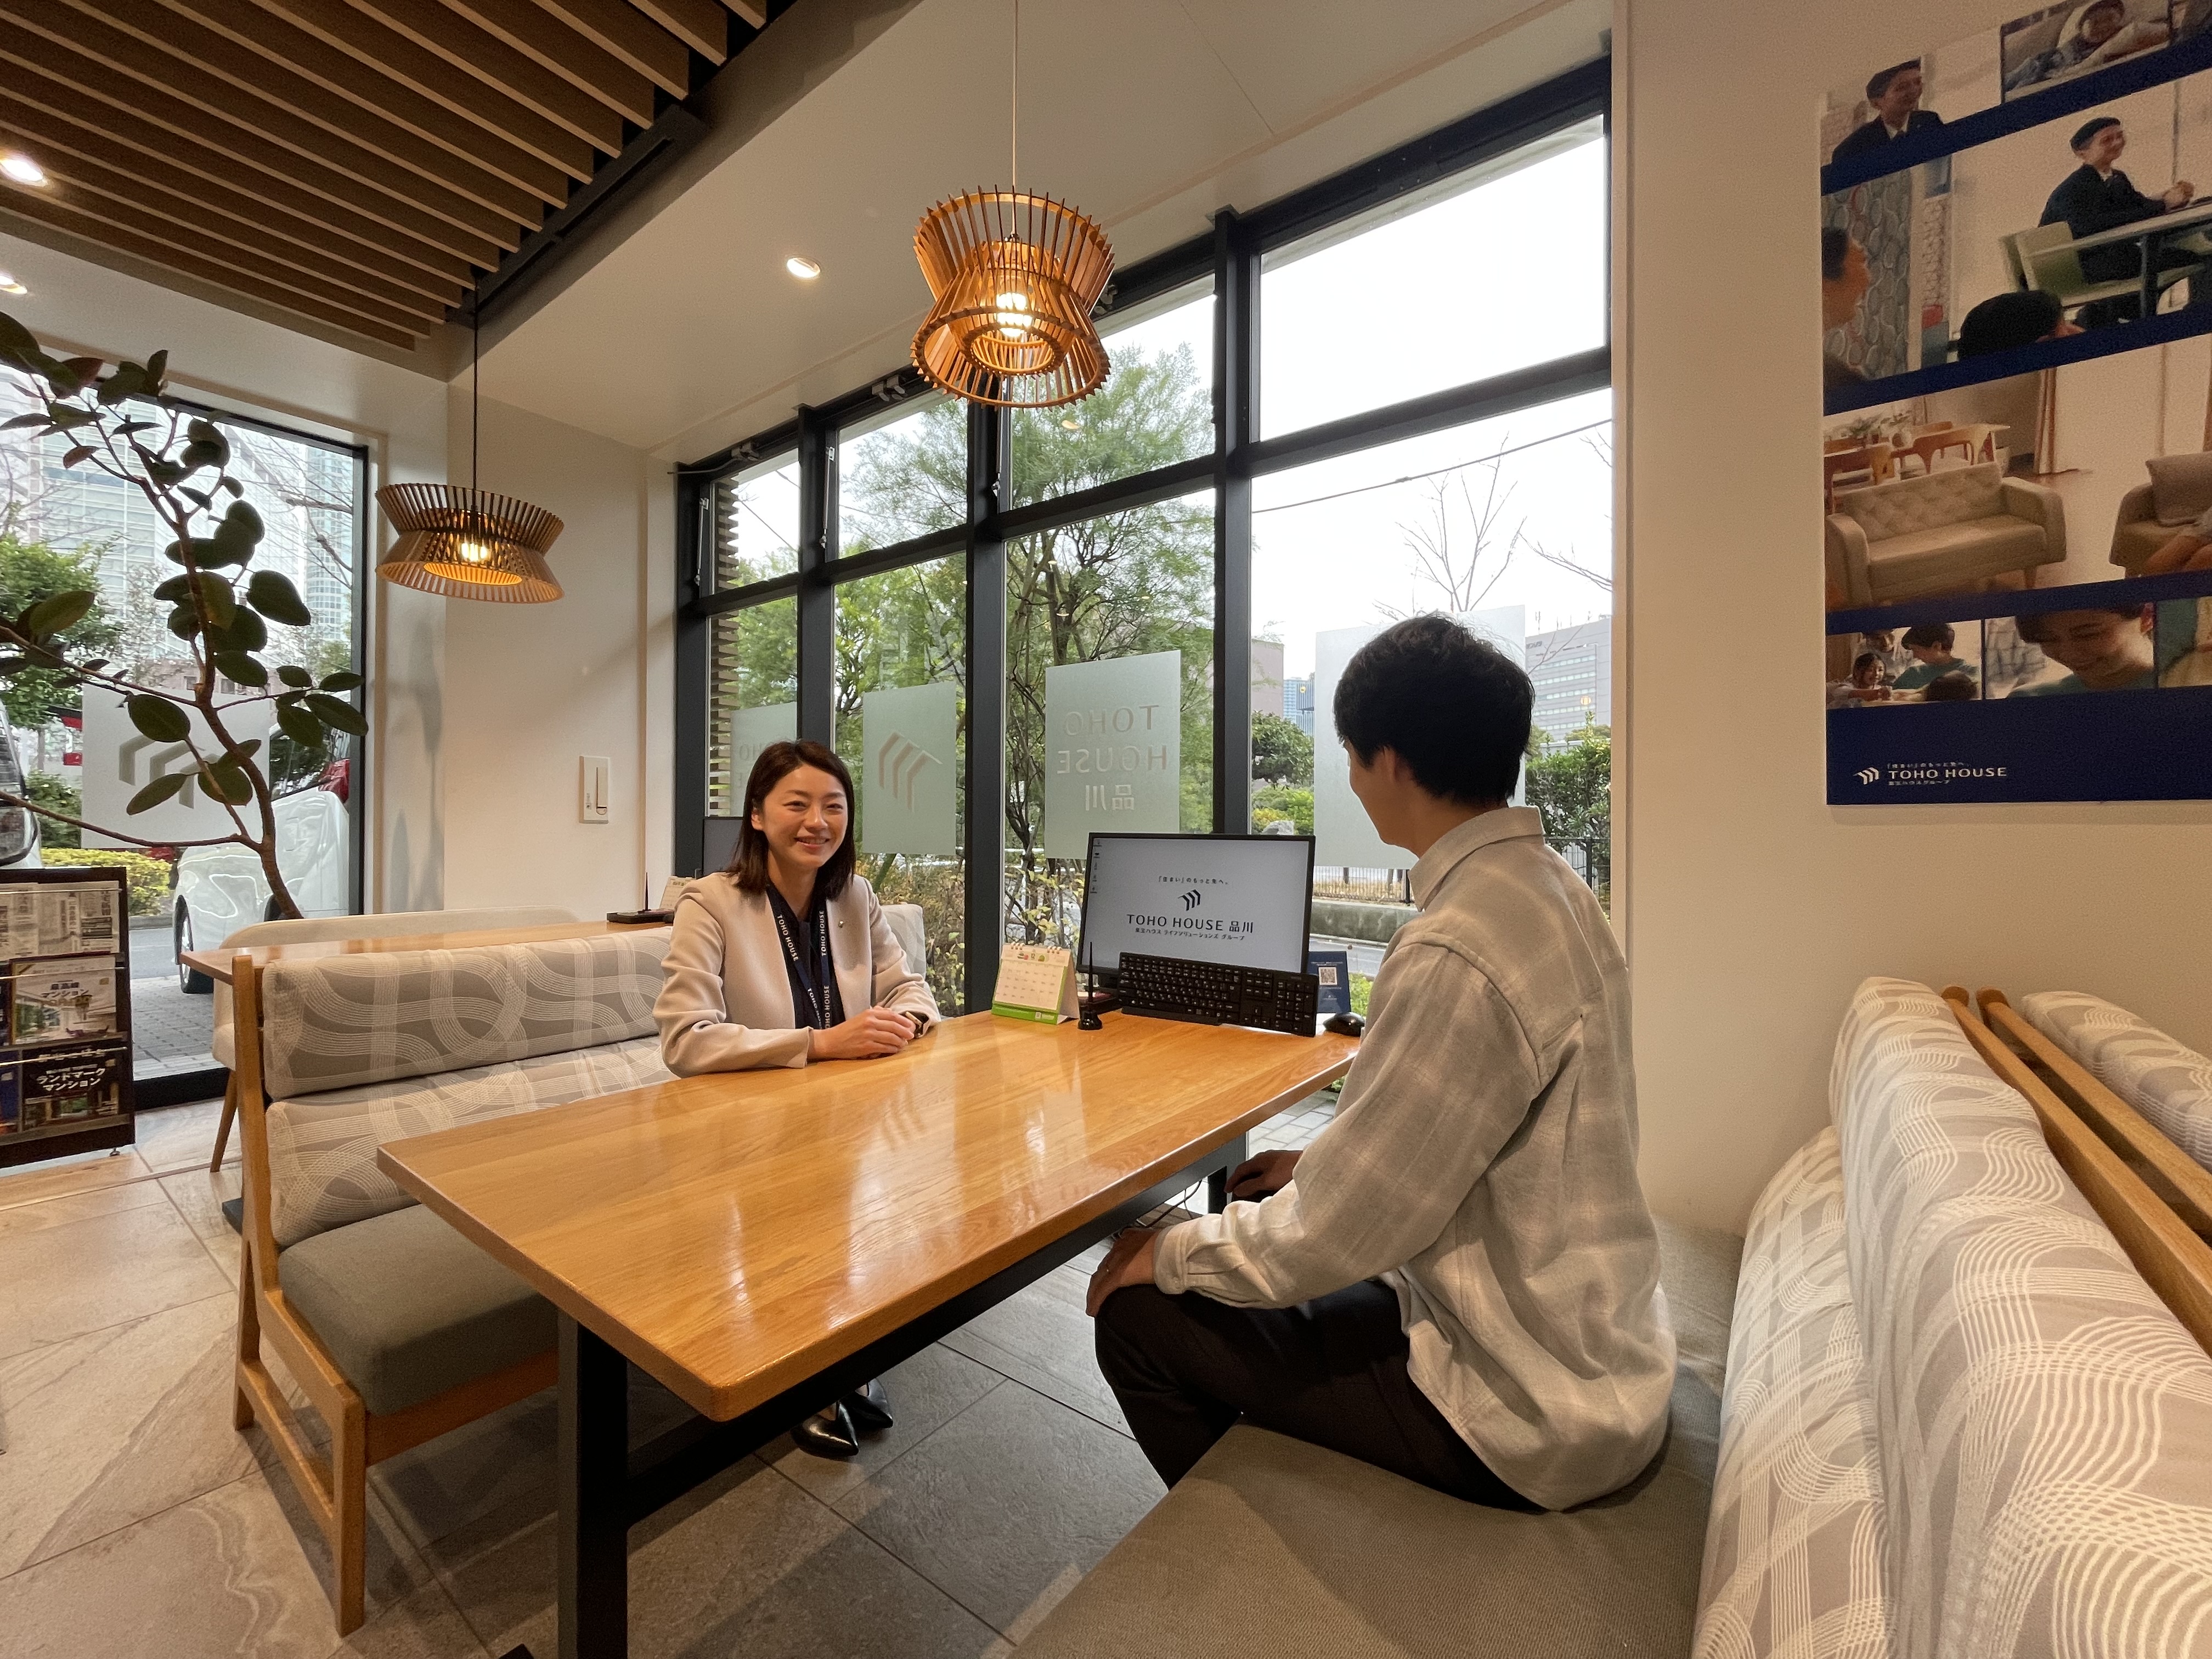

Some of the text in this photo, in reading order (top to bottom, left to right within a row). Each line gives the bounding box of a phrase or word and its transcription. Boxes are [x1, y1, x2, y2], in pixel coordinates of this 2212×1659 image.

[1888, 768, 2007, 779] TOHO HOUSE
[1126, 914, 1254, 933] TOHO HOUSE 品川
[777, 914, 799, 961] TOHO HOUSE
[43, 1078, 101, 1091] マンション
